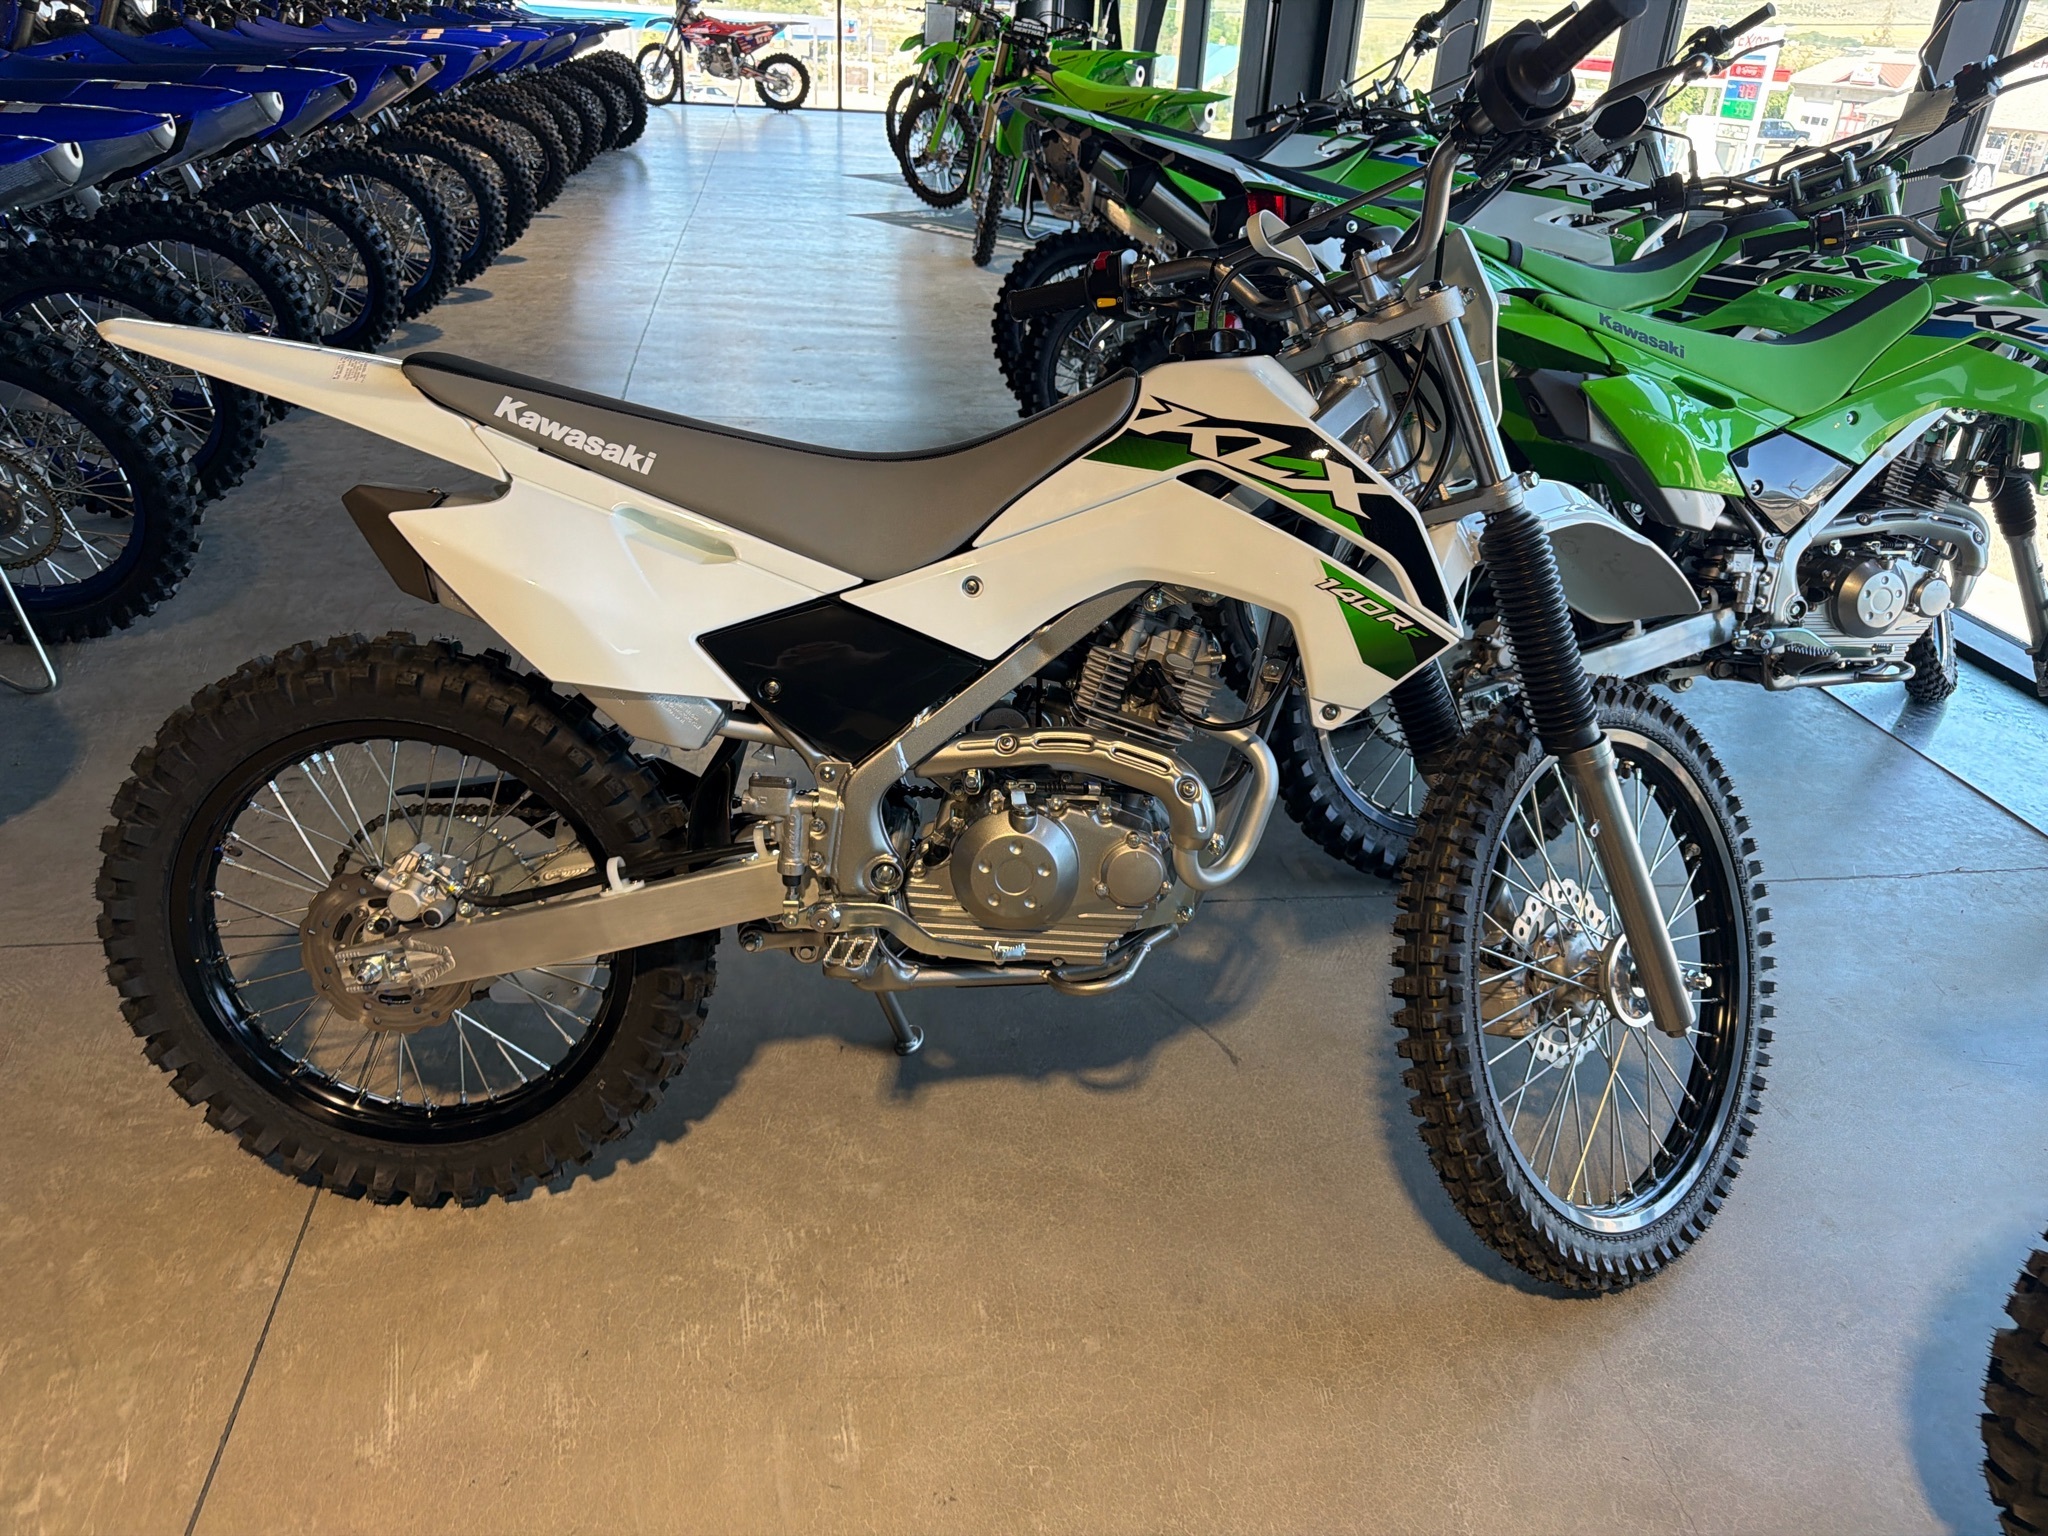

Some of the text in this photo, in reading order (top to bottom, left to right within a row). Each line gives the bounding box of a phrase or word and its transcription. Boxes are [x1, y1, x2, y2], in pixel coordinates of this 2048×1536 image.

[1599, 312, 1685, 359] Kawasaki
[494, 396, 657, 475] Kawasaki
[1132, 395, 1396, 520] KLX
